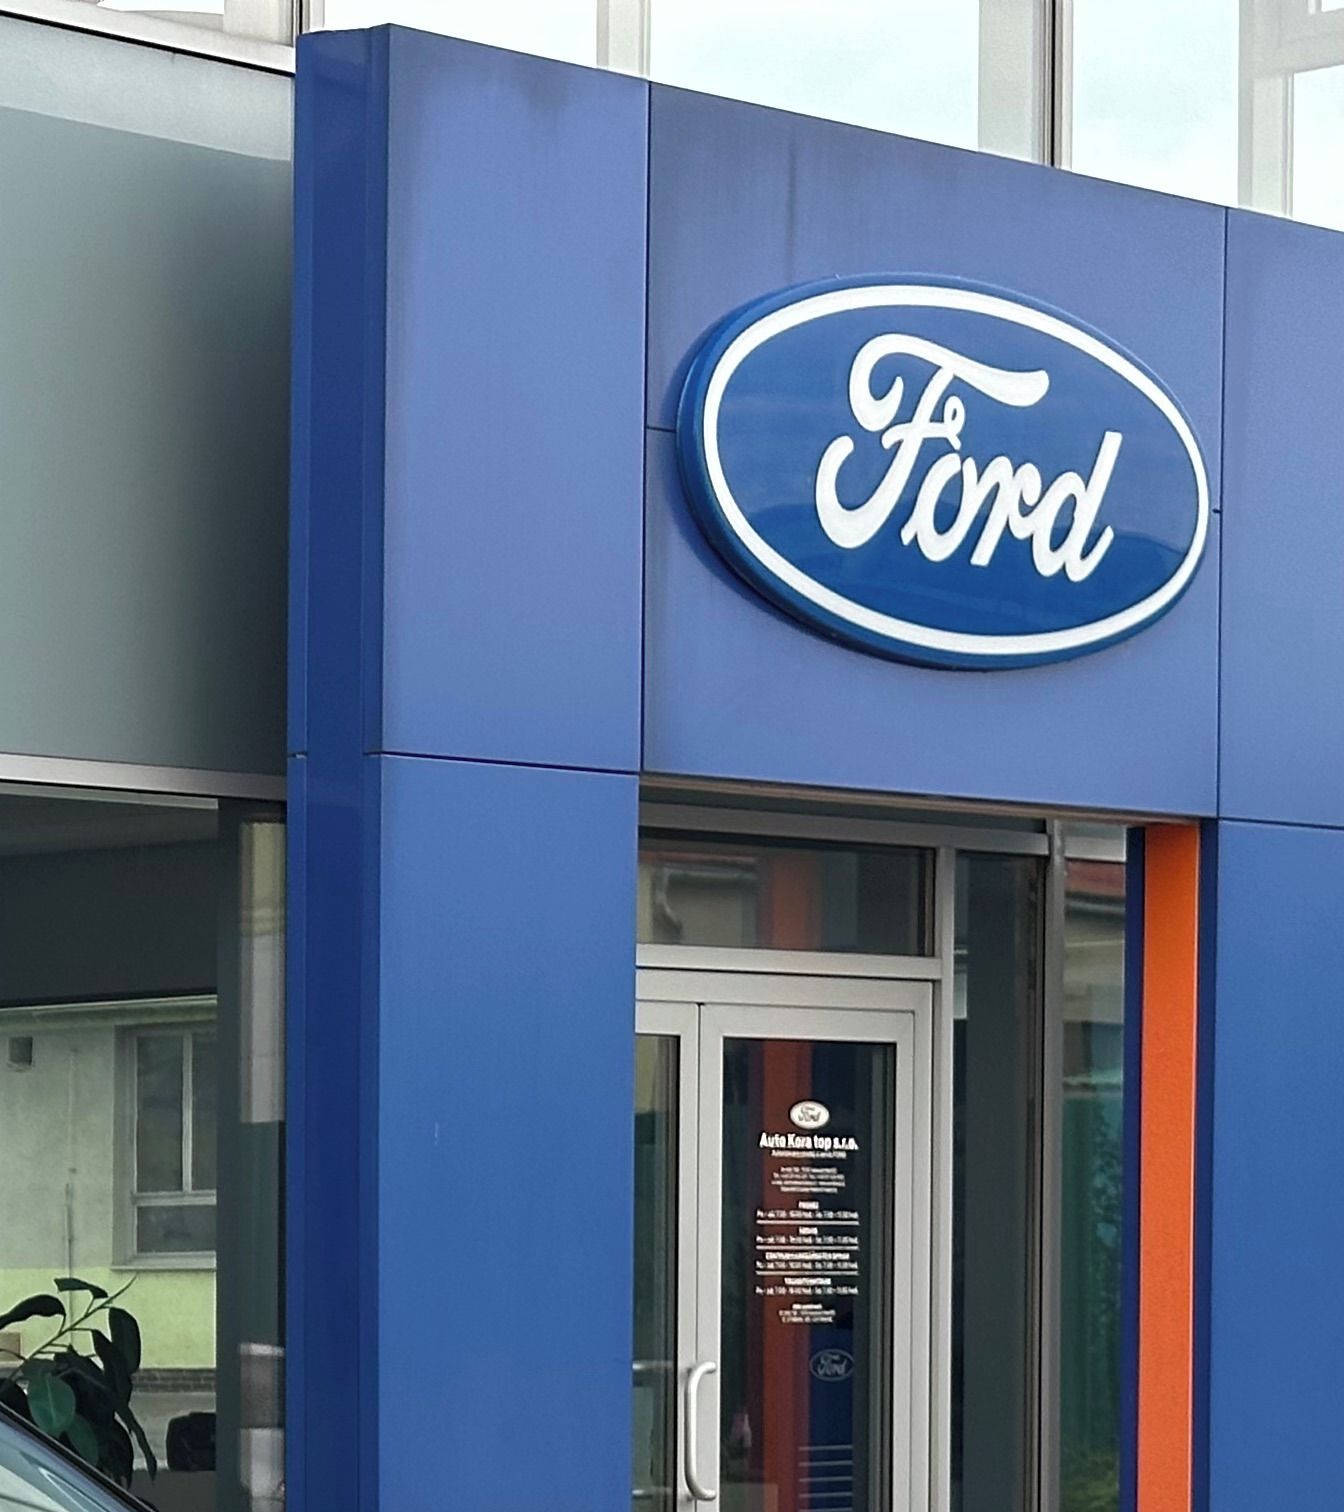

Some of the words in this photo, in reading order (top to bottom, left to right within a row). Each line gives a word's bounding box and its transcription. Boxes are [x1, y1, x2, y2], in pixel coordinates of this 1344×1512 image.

[815, 333, 1123, 582] Ford
[759, 1132, 786, 1148] Auto
[787, 1133, 812, 1148] Kora
[813, 1134, 832, 1151] top
